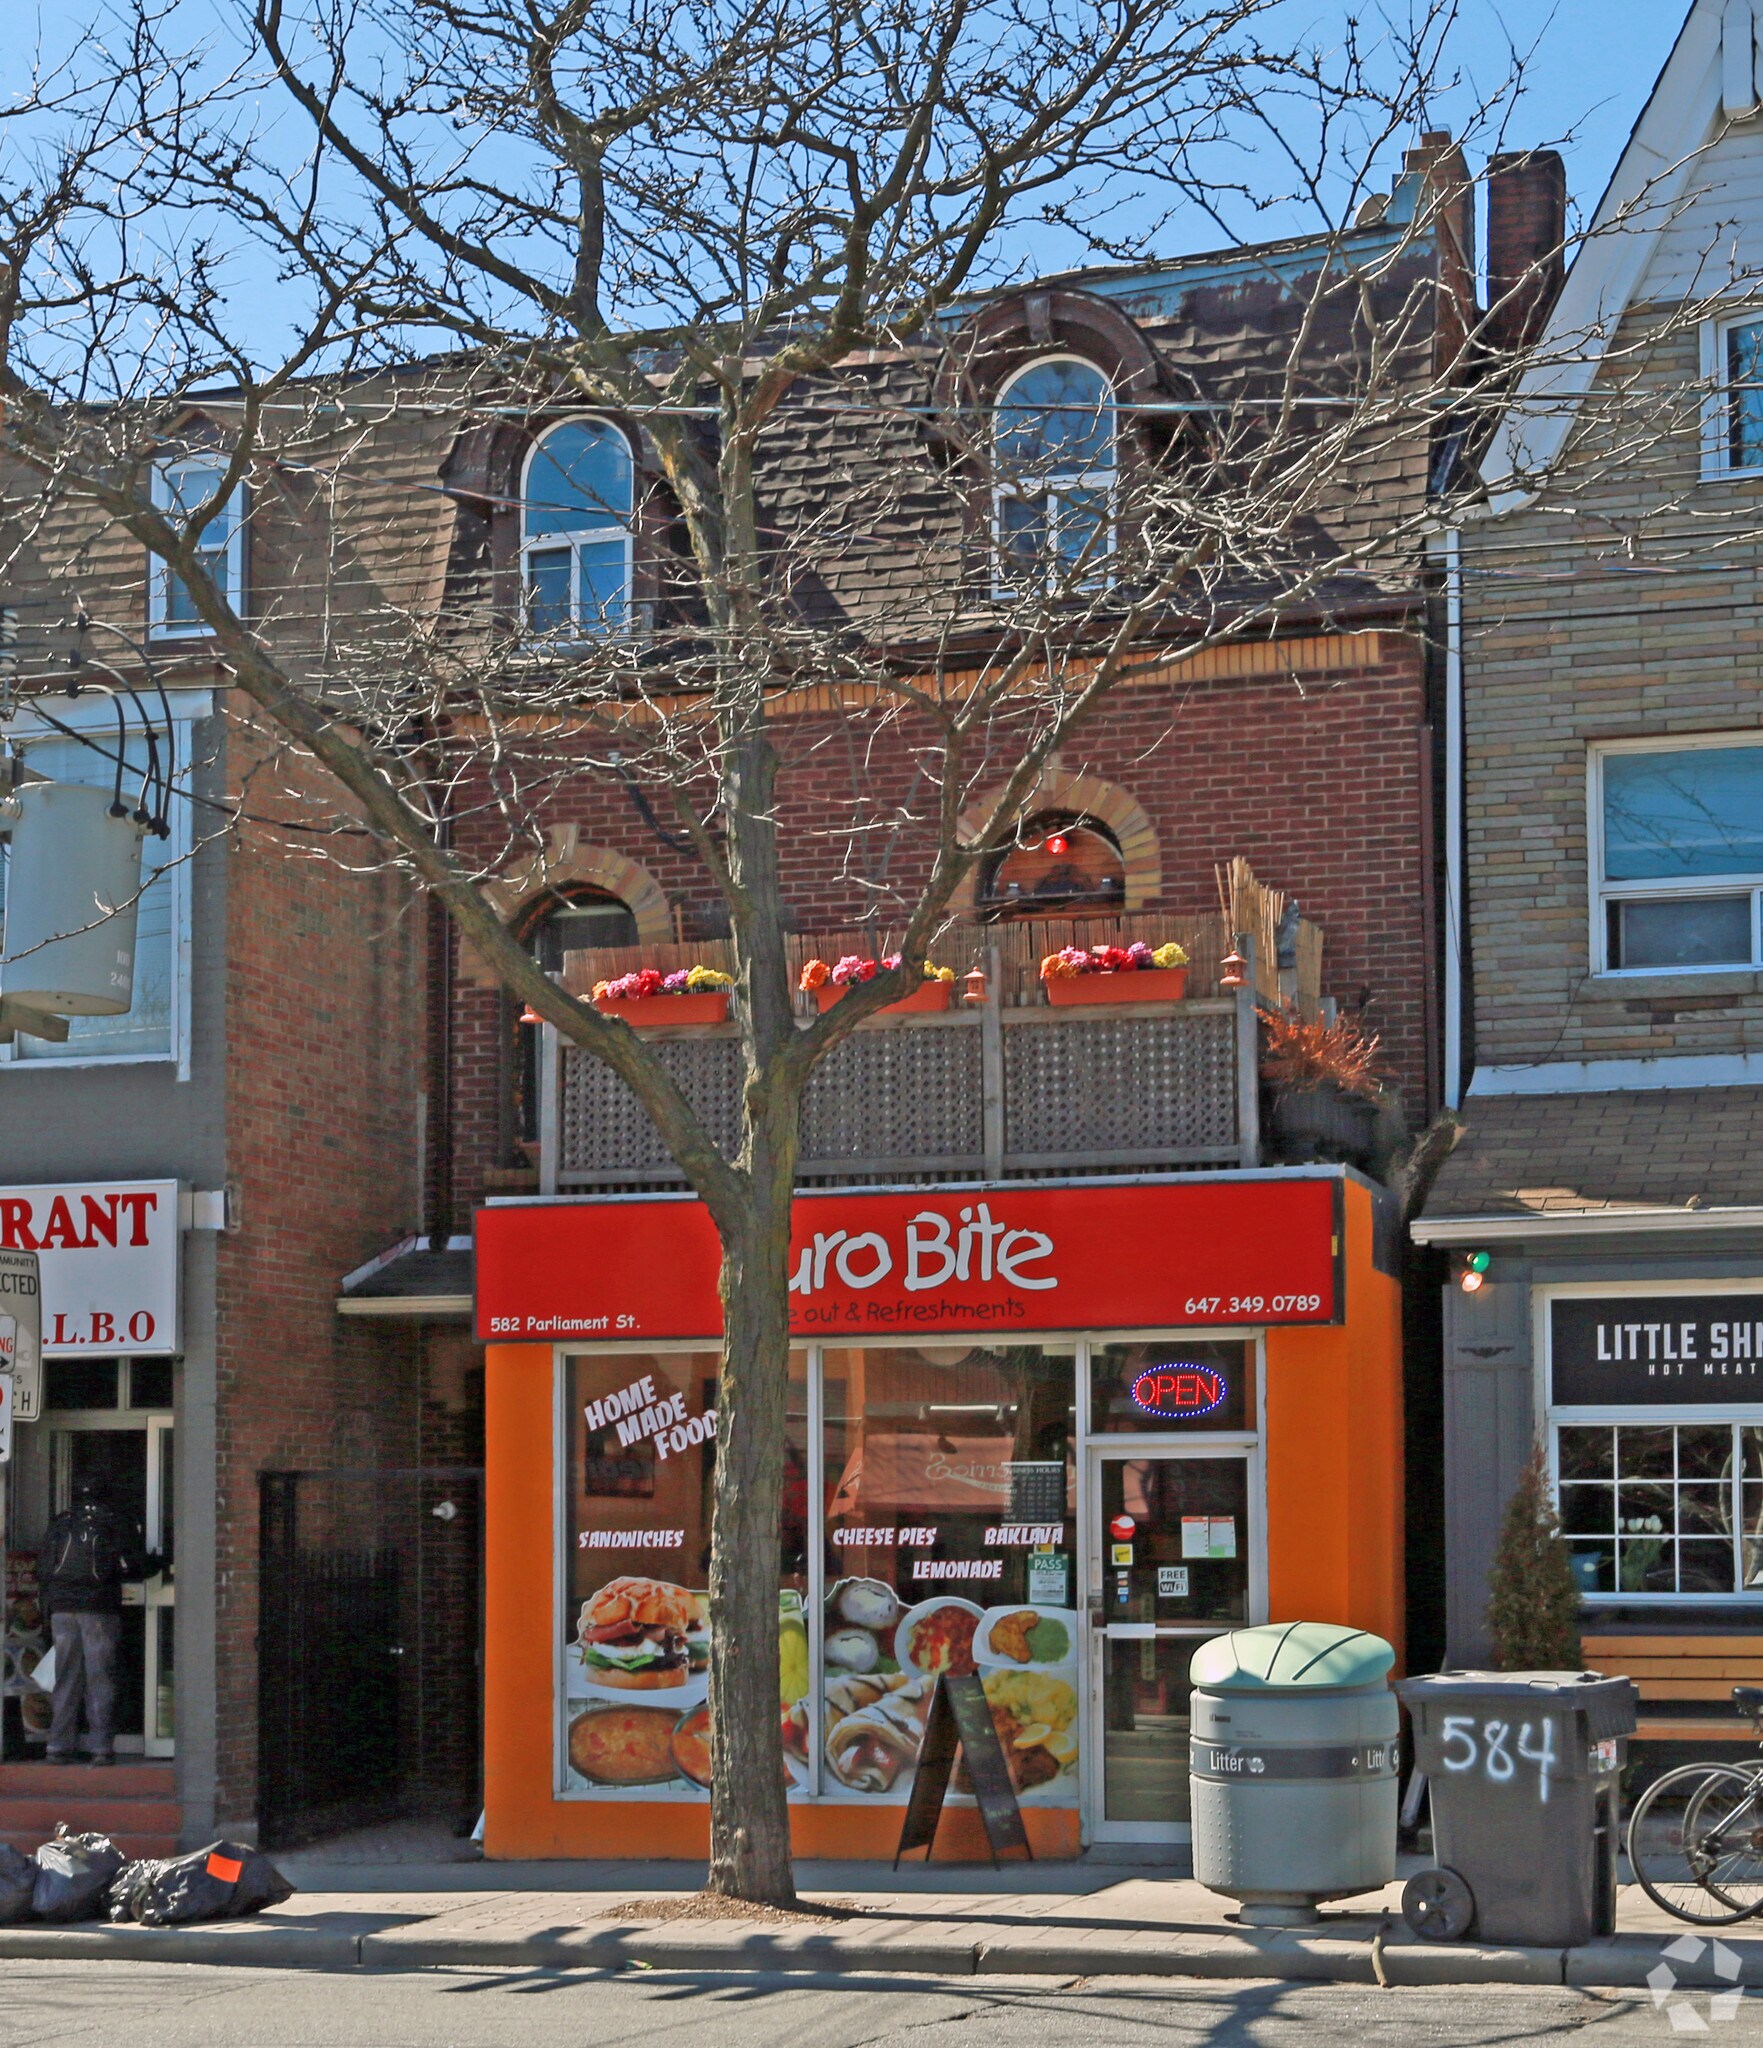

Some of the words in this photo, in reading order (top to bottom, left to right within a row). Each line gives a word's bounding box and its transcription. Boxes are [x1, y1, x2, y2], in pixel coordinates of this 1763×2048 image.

[0, 1193, 157, 1250] RANT
[788, 1229, 893, 1295] uro
[903, 1202, 1058, 1291] Bite
[0, 1256, 35, 1268] MUNITY
[0, 1272, 37, 1296] CTED
[804, 1306, 839, 1323] out
[845, 1303, 861, 1322] &
[867, 1297, 1026, 1323] Refreshments
[1185, 1294, 1321, 1314] 647.349.0789
[490, 1317, 520, 1332] 582
[527, 1315, 609, 1331] Parliament
[615, 1314, 641, 1329] St.
[1597, 1323, 1697, 1360] LITTLE
[1648, 1363, 1684, 1376] HOT
[1704, 1362, 1756, 1375] MEAT
[1135, 1374, 1218, 1406] OPEN
[584, 1375, 657, 1431] HOME
[616, 1392, 688, 1448] MADE
[654, 1409, 718, 1461] FOOD
[579, 1530, 684, 1548] SANDWICHES
[833, 1527, 895, 1545] CHEESE
[898, 1527, 937, 1545] PIES
[984, 1527, 1064, 1545] BAKLAVA
[912, 1560, 1003, 1579] LEMONADE
[1034, 1559, 1062, 1570] PASS
[1160, 1570, 1186, 1579] FREE
[1210, 1750, 1244, 1771] Litter
[1443, 1717, 1555, 1804] 584
